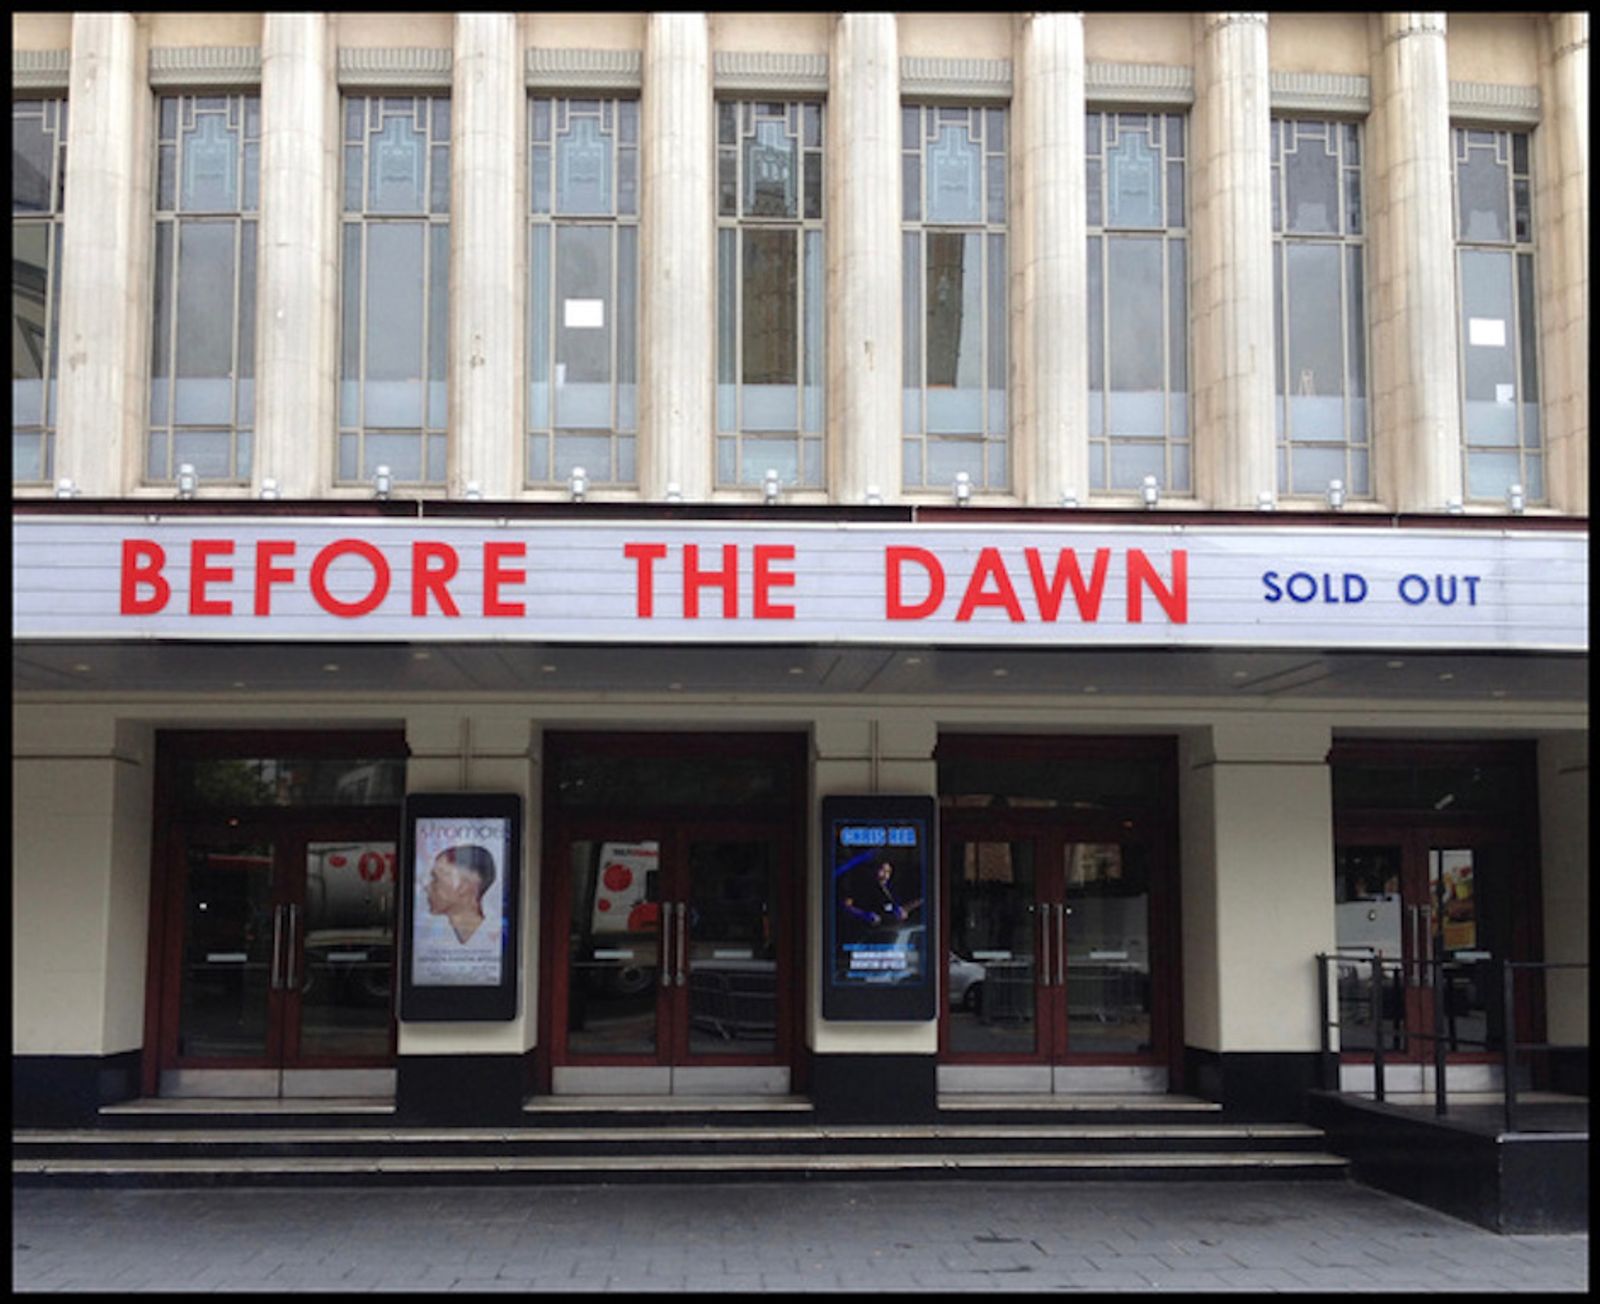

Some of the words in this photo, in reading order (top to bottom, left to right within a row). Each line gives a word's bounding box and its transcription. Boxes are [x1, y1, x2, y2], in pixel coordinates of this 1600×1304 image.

[119, 538, 527, 619] BEFORE
[623, 542, 796, 620] THE
[885, 545, 1189, 625] DAWN
[1263, 570, 1368, 605] SOLD
[1398, 573, 1480, 607] OUT
